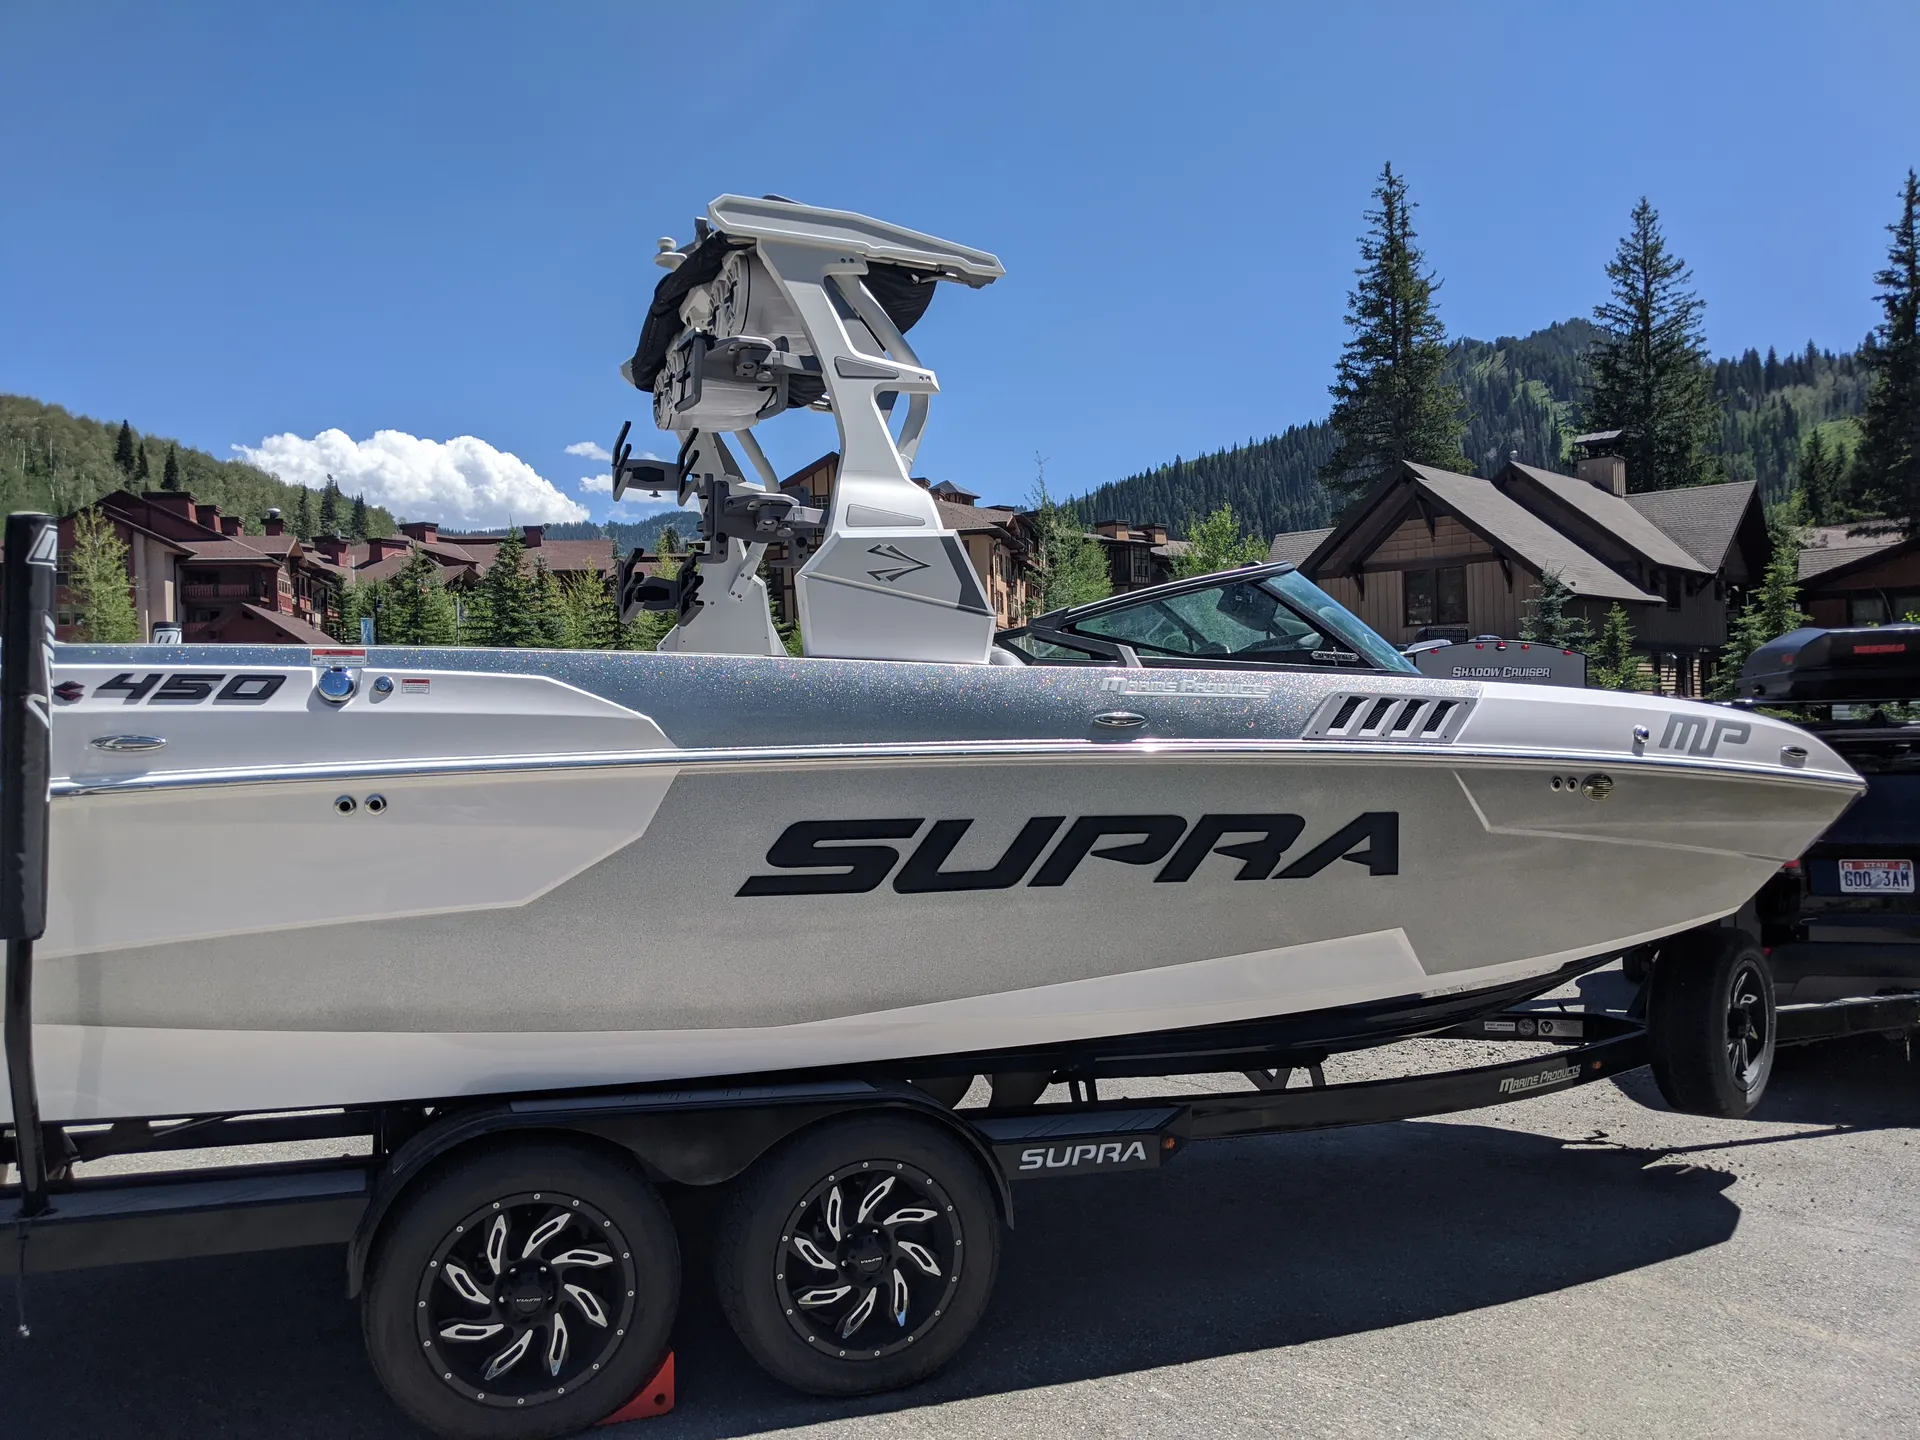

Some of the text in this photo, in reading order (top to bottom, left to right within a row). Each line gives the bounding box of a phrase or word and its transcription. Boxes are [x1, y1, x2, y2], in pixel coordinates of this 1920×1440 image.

[1452, 666, 1551, 678] SHADOW CRUISER
[97, 673, 287, 701] 450
[1179, 679, 1271, 696] PRODUCTS
[735, 812, 1400, 897] SUPRA
[1882, 870, 1910, 887] 3AM
[1499, 1064, 1582, 1094] MARINE PRODUCTS
[1018, 1141, 1147, 1171] SUPRA
